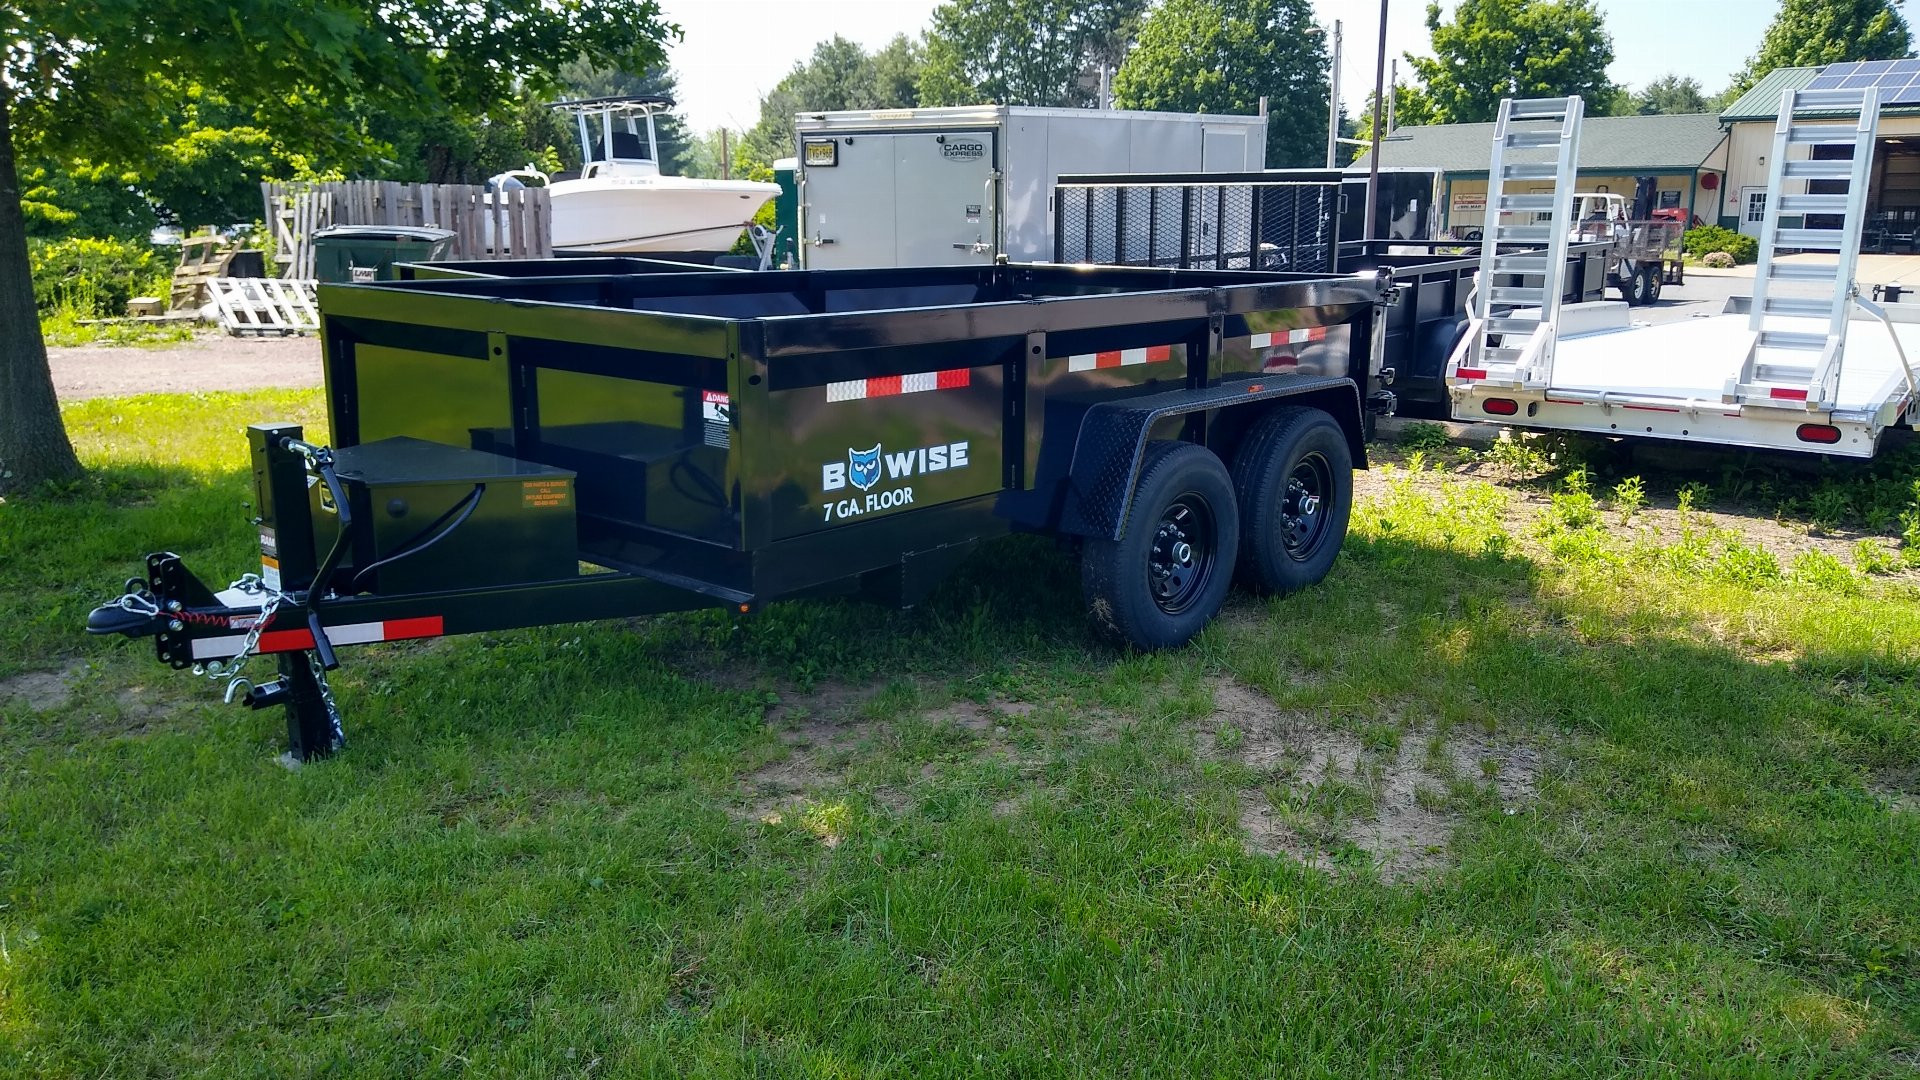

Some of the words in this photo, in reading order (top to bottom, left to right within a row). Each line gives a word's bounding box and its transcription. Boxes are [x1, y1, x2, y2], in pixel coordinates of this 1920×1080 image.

[823, 502, 834, 522] 7
[836, 498, 864, 519] GA.
[866, 486, 914, 513] FLOOR
